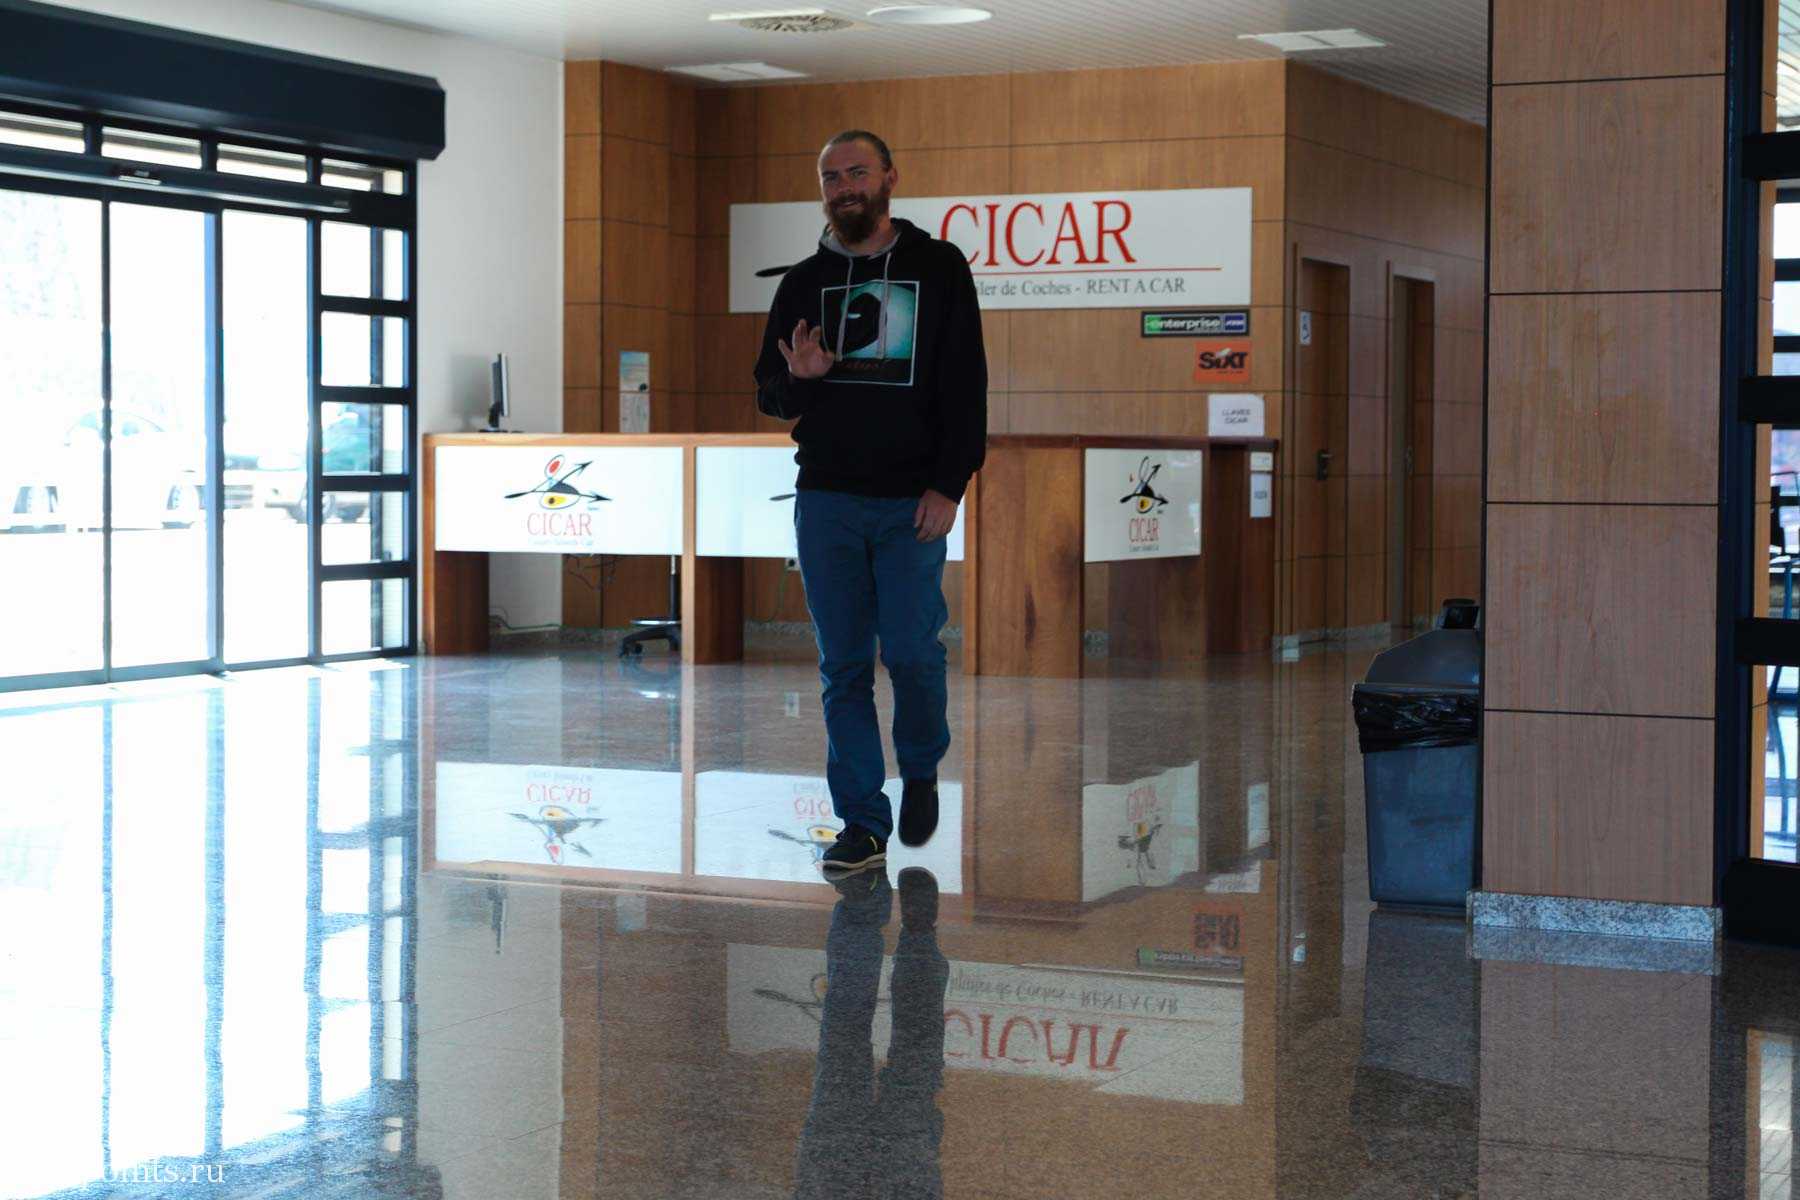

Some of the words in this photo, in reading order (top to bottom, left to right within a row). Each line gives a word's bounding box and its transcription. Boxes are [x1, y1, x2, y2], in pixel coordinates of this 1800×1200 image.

[940, 200, 1137, 267] CICAR
[1001, 280, 1017, 296] de
[1021, 280, 1072, 296] Coches
[1087, 278, 1130, 294] RENT
[1134, 278, 1147, 293] A
[1149, 276, 1187, 293] CAR
[527, 512, 593, 537] CICAR
